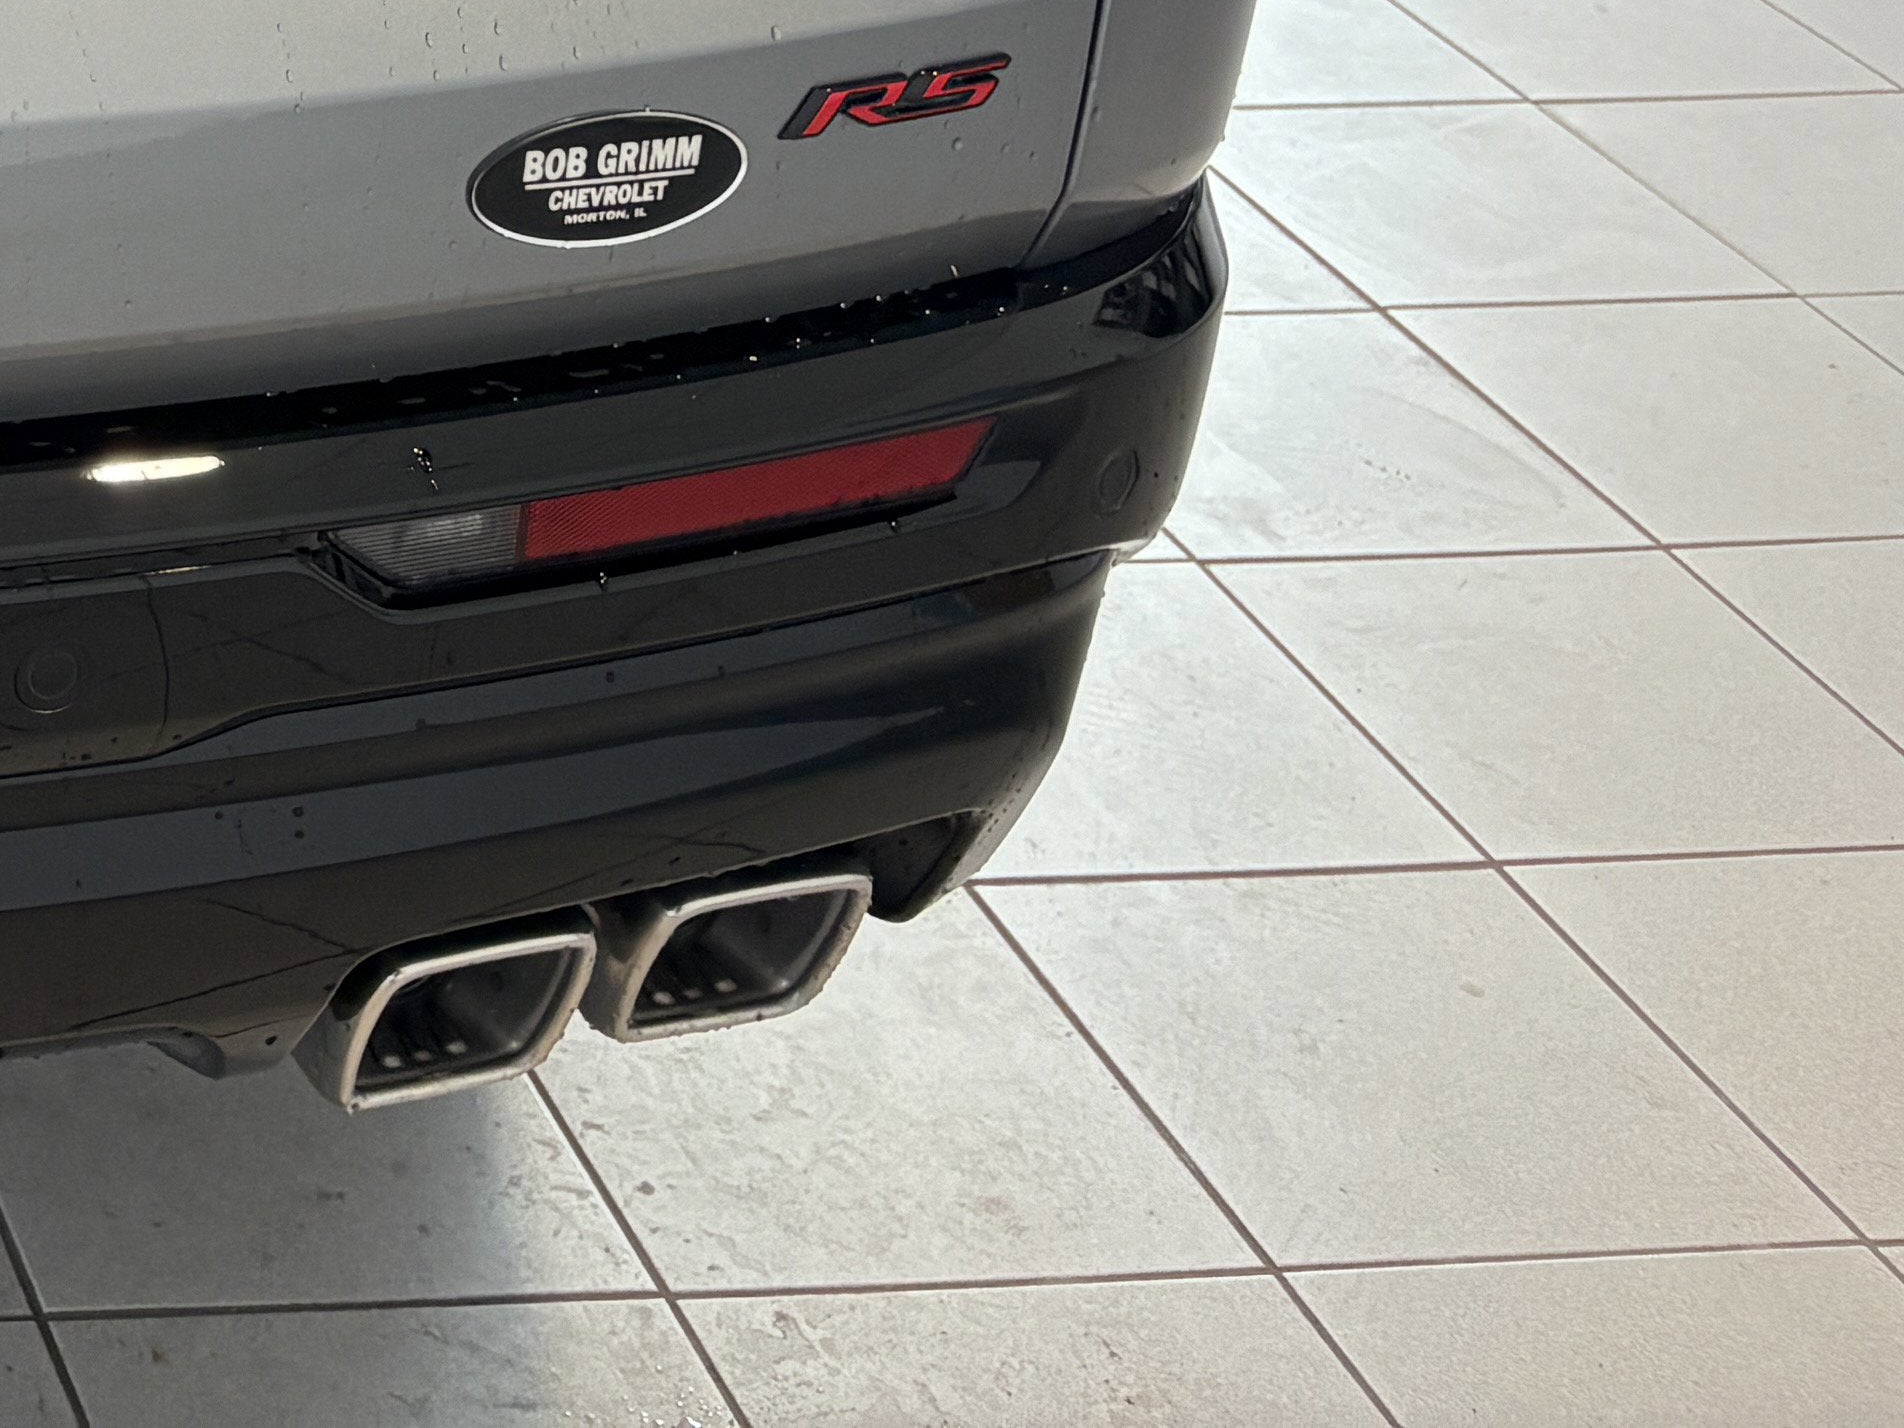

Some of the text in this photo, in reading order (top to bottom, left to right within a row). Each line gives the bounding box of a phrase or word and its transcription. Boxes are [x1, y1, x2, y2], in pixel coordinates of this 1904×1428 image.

[776, 51, 1013, 141] RS
[522, 134, 703, 183] BOB GRIMM
[548, 179, 669, 212] CHEVROLET
[563, 207, 647, 225] MORTON, IL
